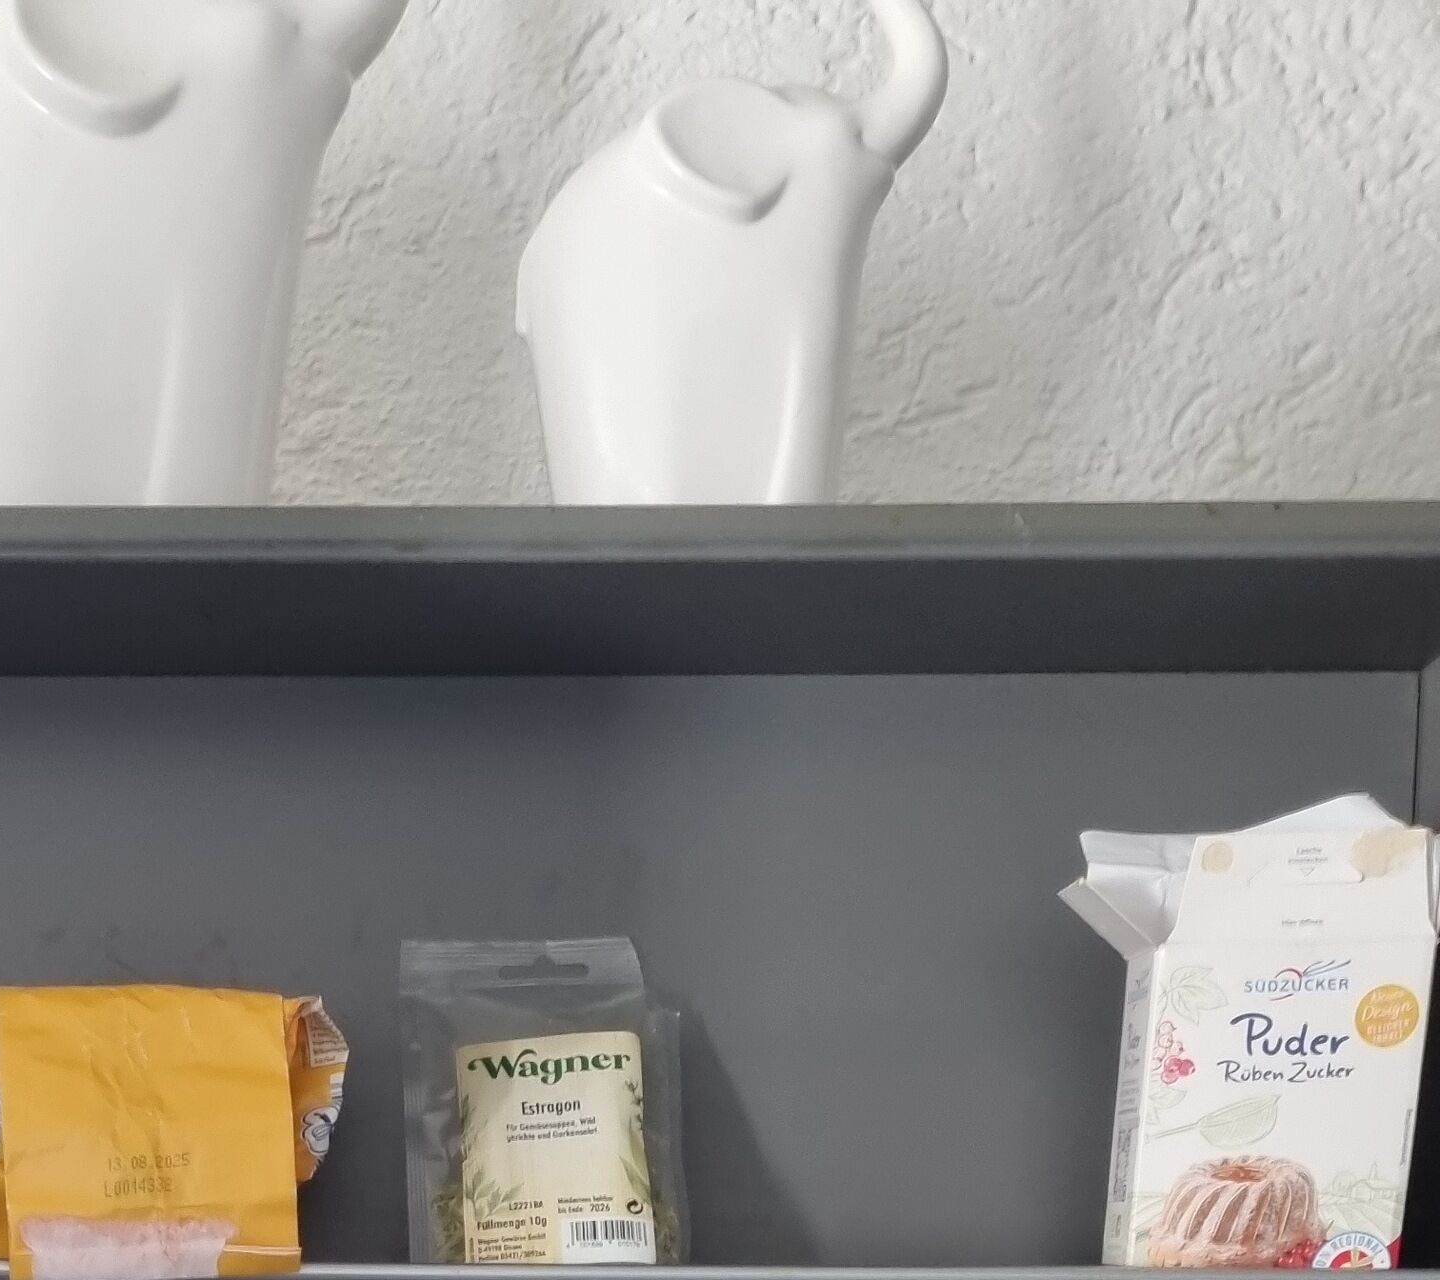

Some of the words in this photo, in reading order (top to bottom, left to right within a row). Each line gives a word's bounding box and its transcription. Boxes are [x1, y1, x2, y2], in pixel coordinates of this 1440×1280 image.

[1244, 977, 1349, 994] SÜDZUCKER
[1230, 1012, 1350, 1056] Puder
[467, 1049, 631, 1085] Wagner
[1217, 1060, 1283, 1083] Rüben
[1287, 1061, 1355, 1083] Zucker
[521, 1100, 580, 1116] Estragon
[477, 1219, 526, 1231] Füllmenge
[530, 1216, 547, 1227] 10g
